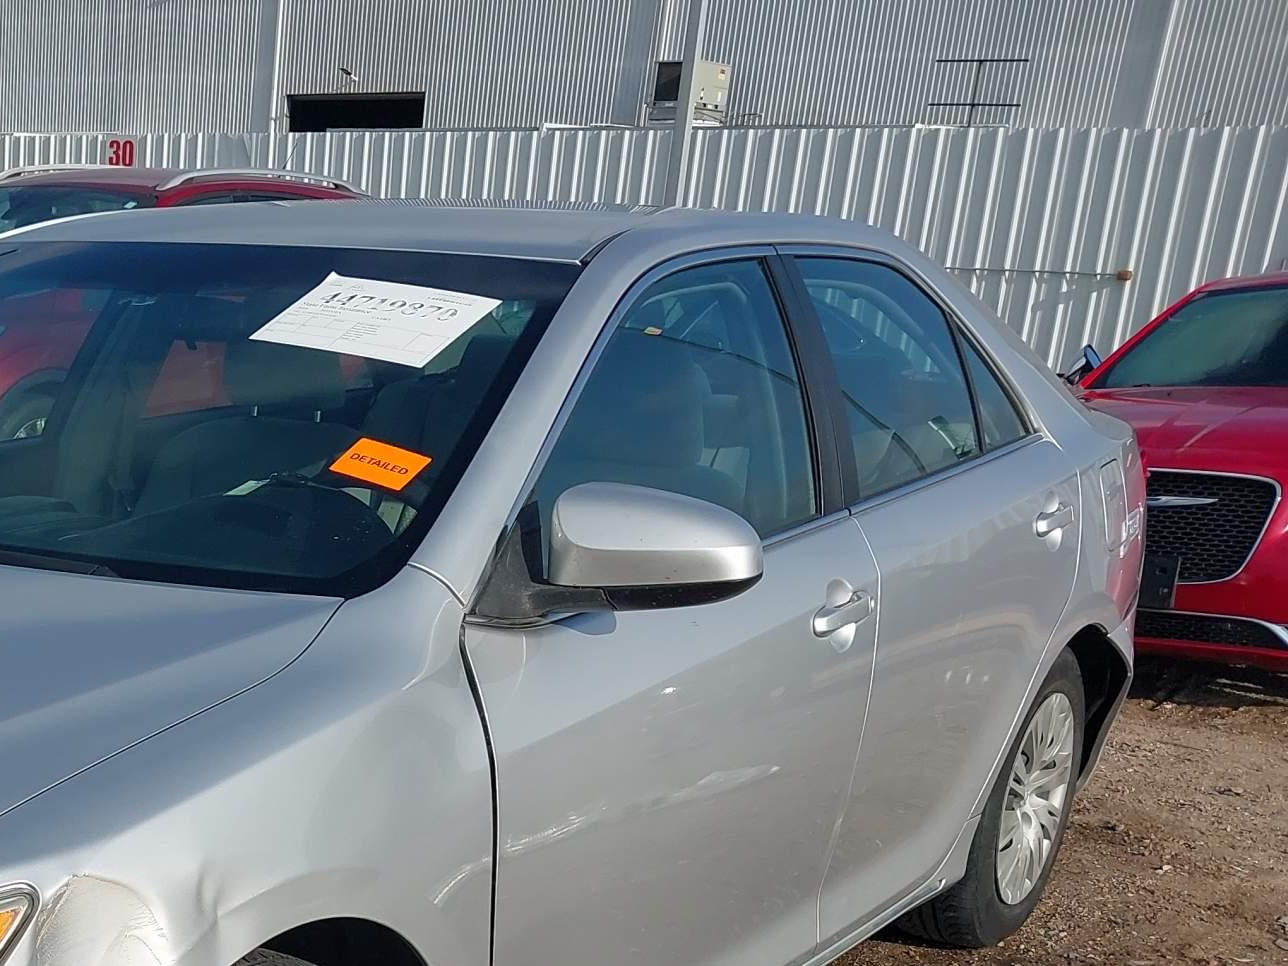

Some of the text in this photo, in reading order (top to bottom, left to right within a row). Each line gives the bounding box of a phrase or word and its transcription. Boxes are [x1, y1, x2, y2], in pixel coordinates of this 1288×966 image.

[108, 140, 135, 167] 30
[320, 292, 458, 321] 44719870
[350, 453, 409, 475] DETAILED
